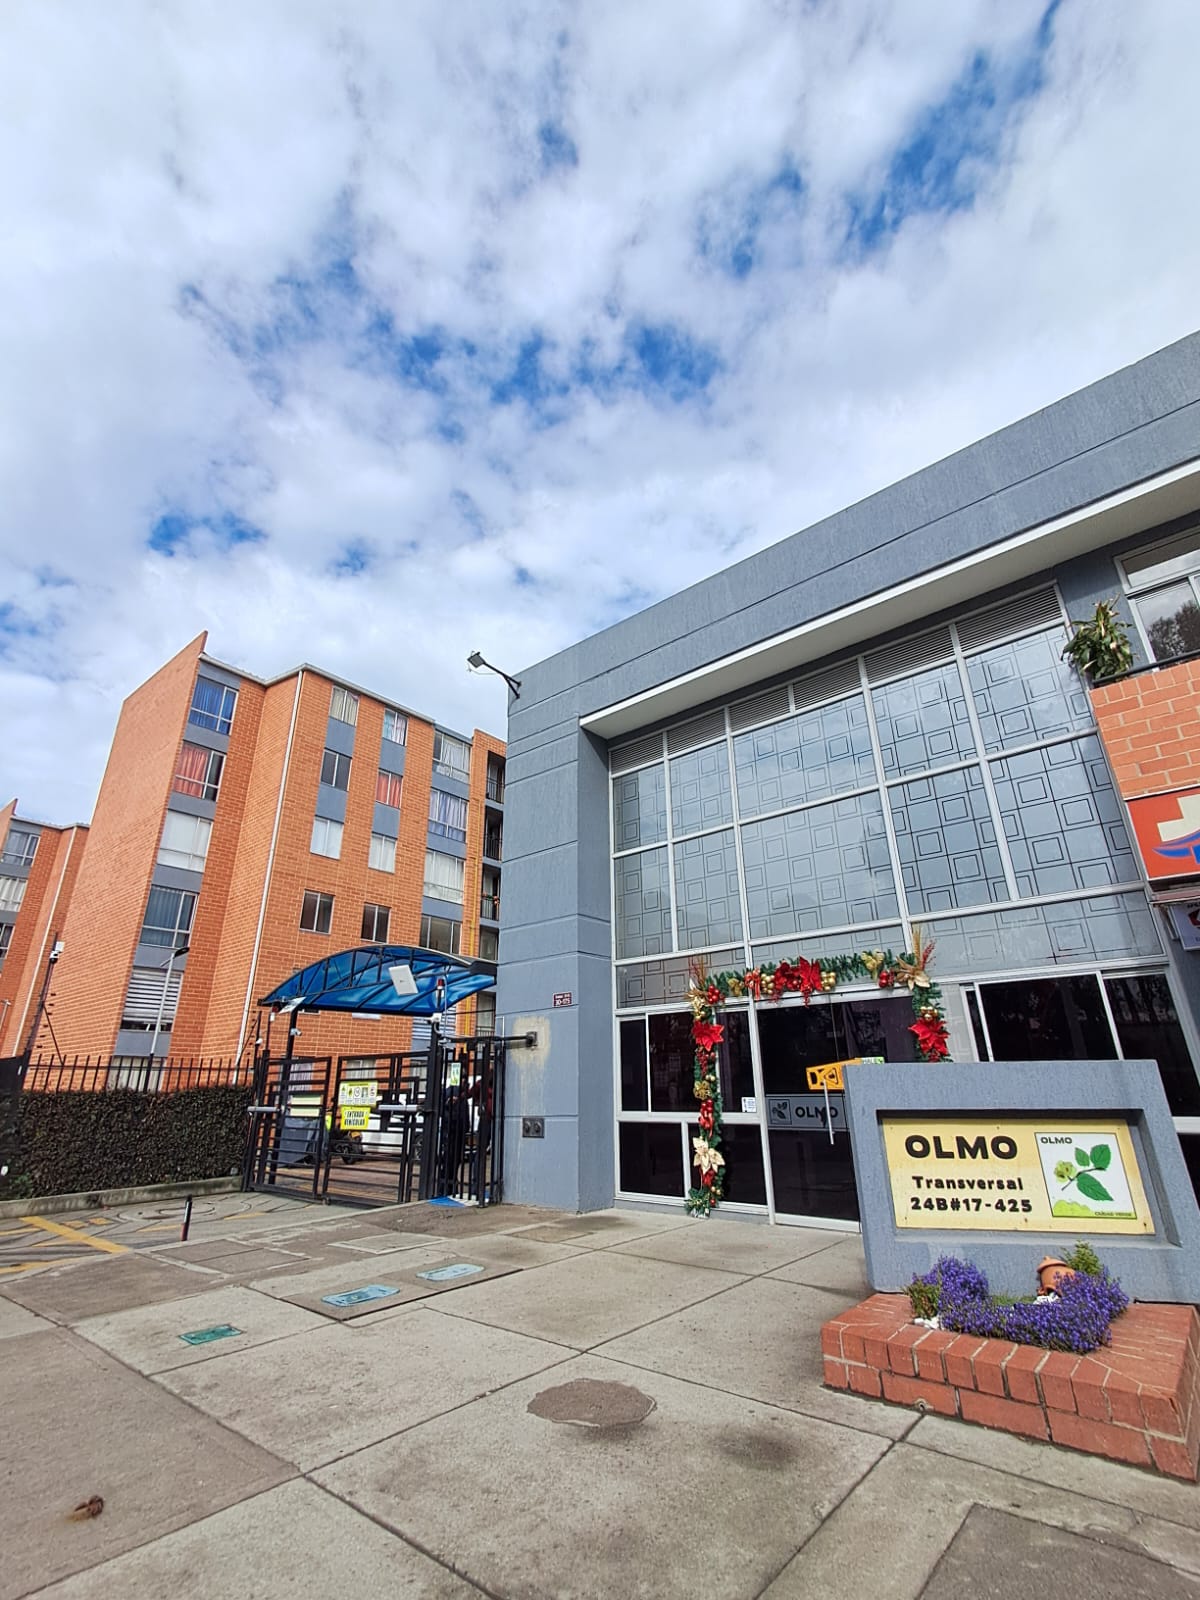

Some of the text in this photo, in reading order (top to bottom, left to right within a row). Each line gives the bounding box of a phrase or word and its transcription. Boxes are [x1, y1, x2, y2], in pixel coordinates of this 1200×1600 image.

[905, 1134, 1018, 1160] OLMO
[1040, 1136, 1073, 1144] OLMO
[911, 1175, 1024, 1190] Transversal
[910, 1197, 1033, 1213] 24B#17-425
